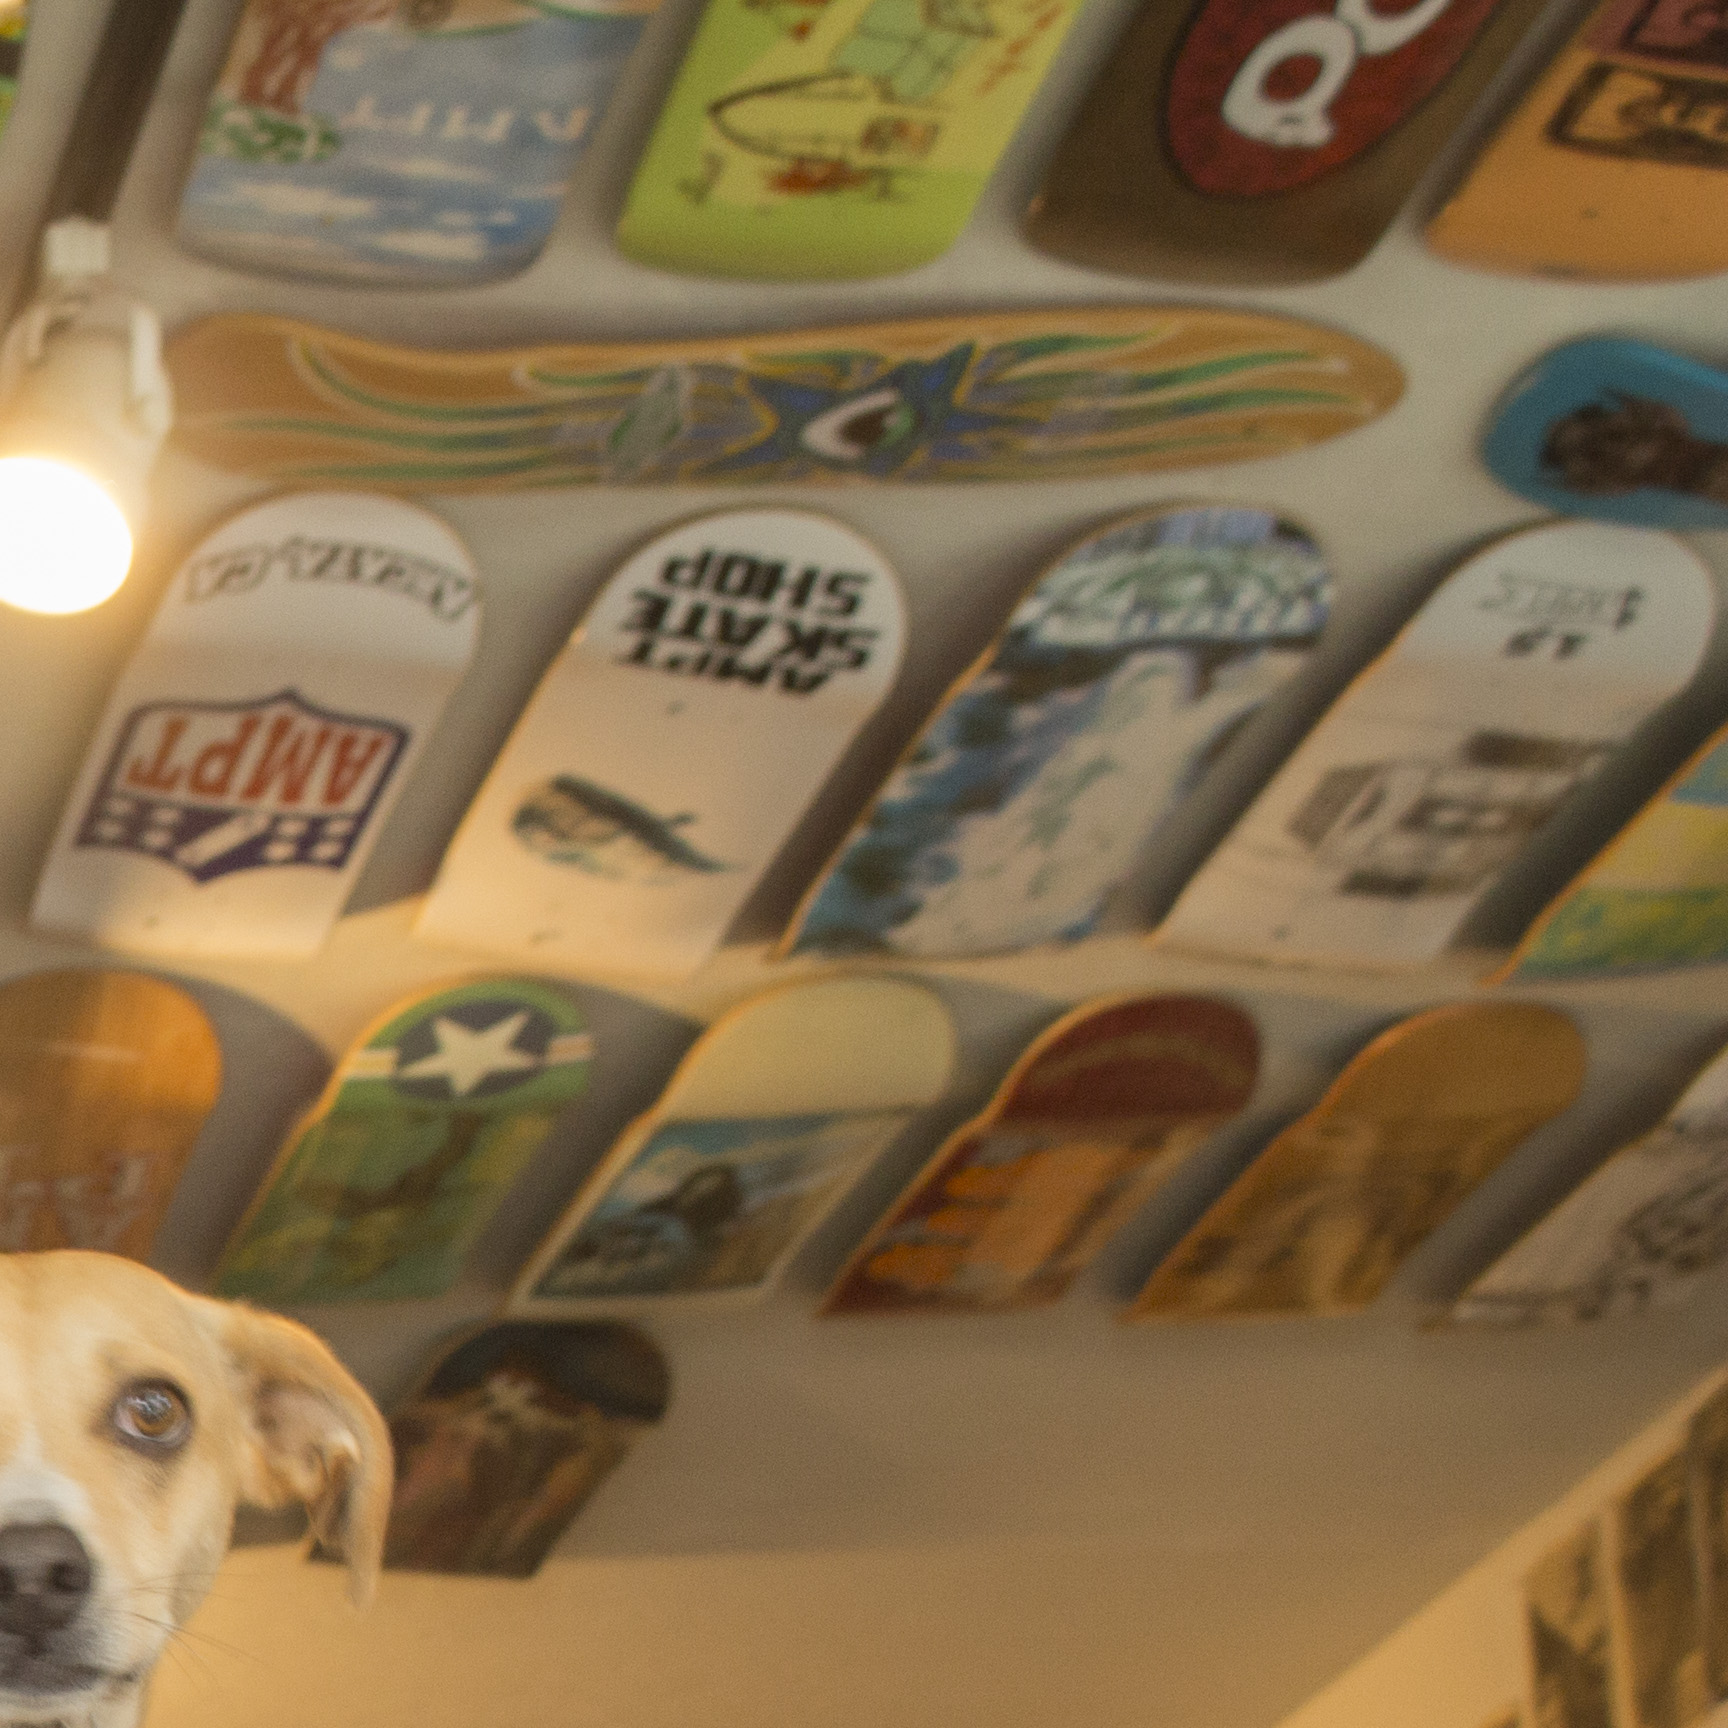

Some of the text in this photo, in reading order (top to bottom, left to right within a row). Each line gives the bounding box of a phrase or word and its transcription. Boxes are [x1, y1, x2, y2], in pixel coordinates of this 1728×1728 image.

[663, 548, 870, 617] SHOP
[614, 636, 832, 694] AMPT
[620, 586, 880, 672] SKATE
[126, 712, 389, 808] AMPT
